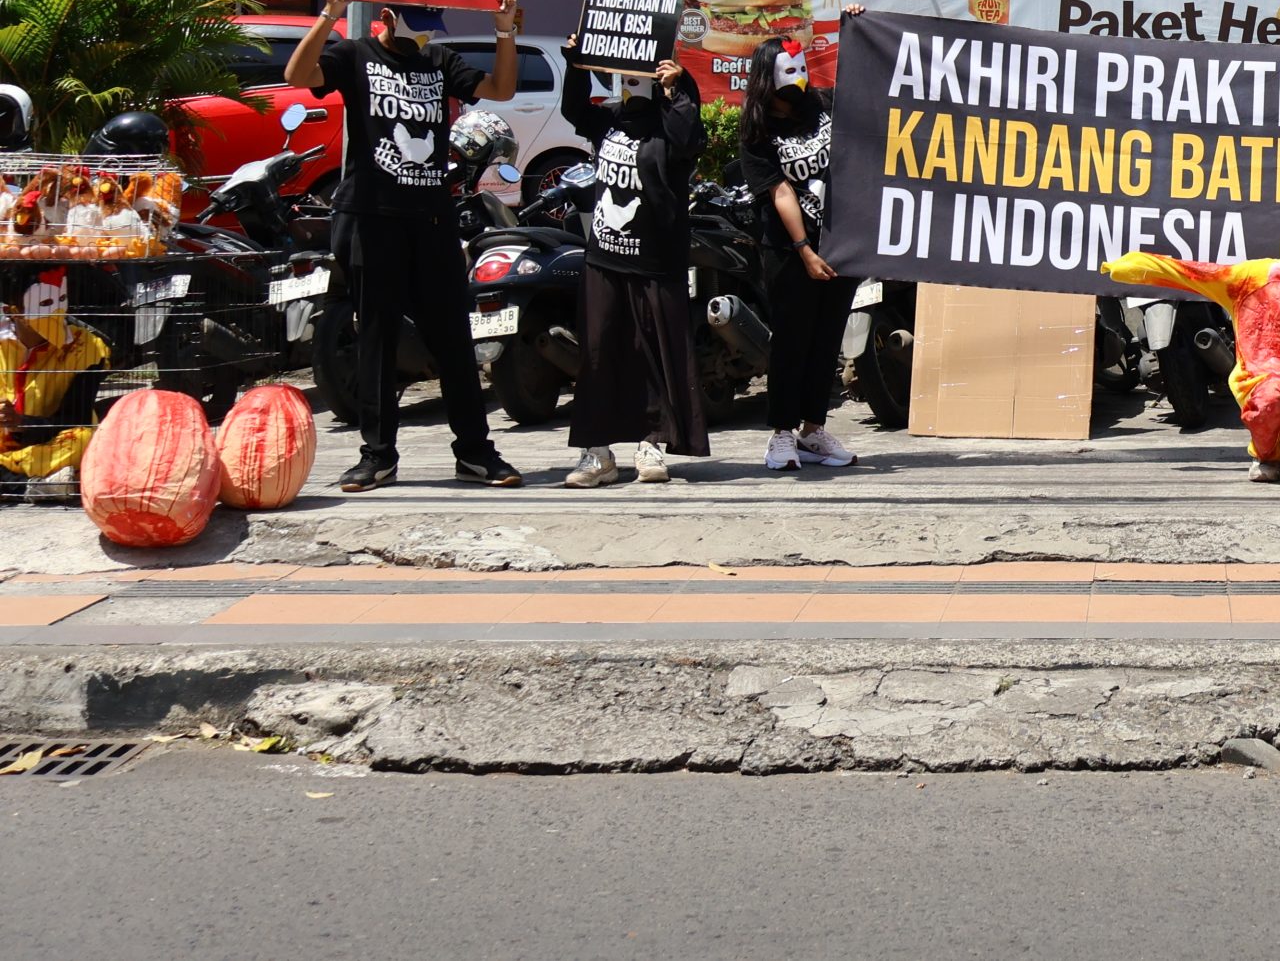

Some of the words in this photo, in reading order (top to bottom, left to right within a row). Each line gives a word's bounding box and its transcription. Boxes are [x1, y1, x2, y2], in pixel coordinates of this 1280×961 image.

[586, 9, 624, 32] TIDAK
[623, 13, 653, 36] BISA
[680, 24, 705, 34] BURGER
[683, 16, 701, 27] BEST
[978, 8, 1001, 22] TEA
[581, 32, 658, 62] DIBIARKAN
[712, 58, 744, 74] Beef
[888, 31, 1077, 115] AKHIRI
[369, 93, 443, 124] KOSONG
[884, 107, 1153, 198] KANDANG
[877, 186, 934, 259] DI
[950, 192, 1248, 271] INDONESIA
